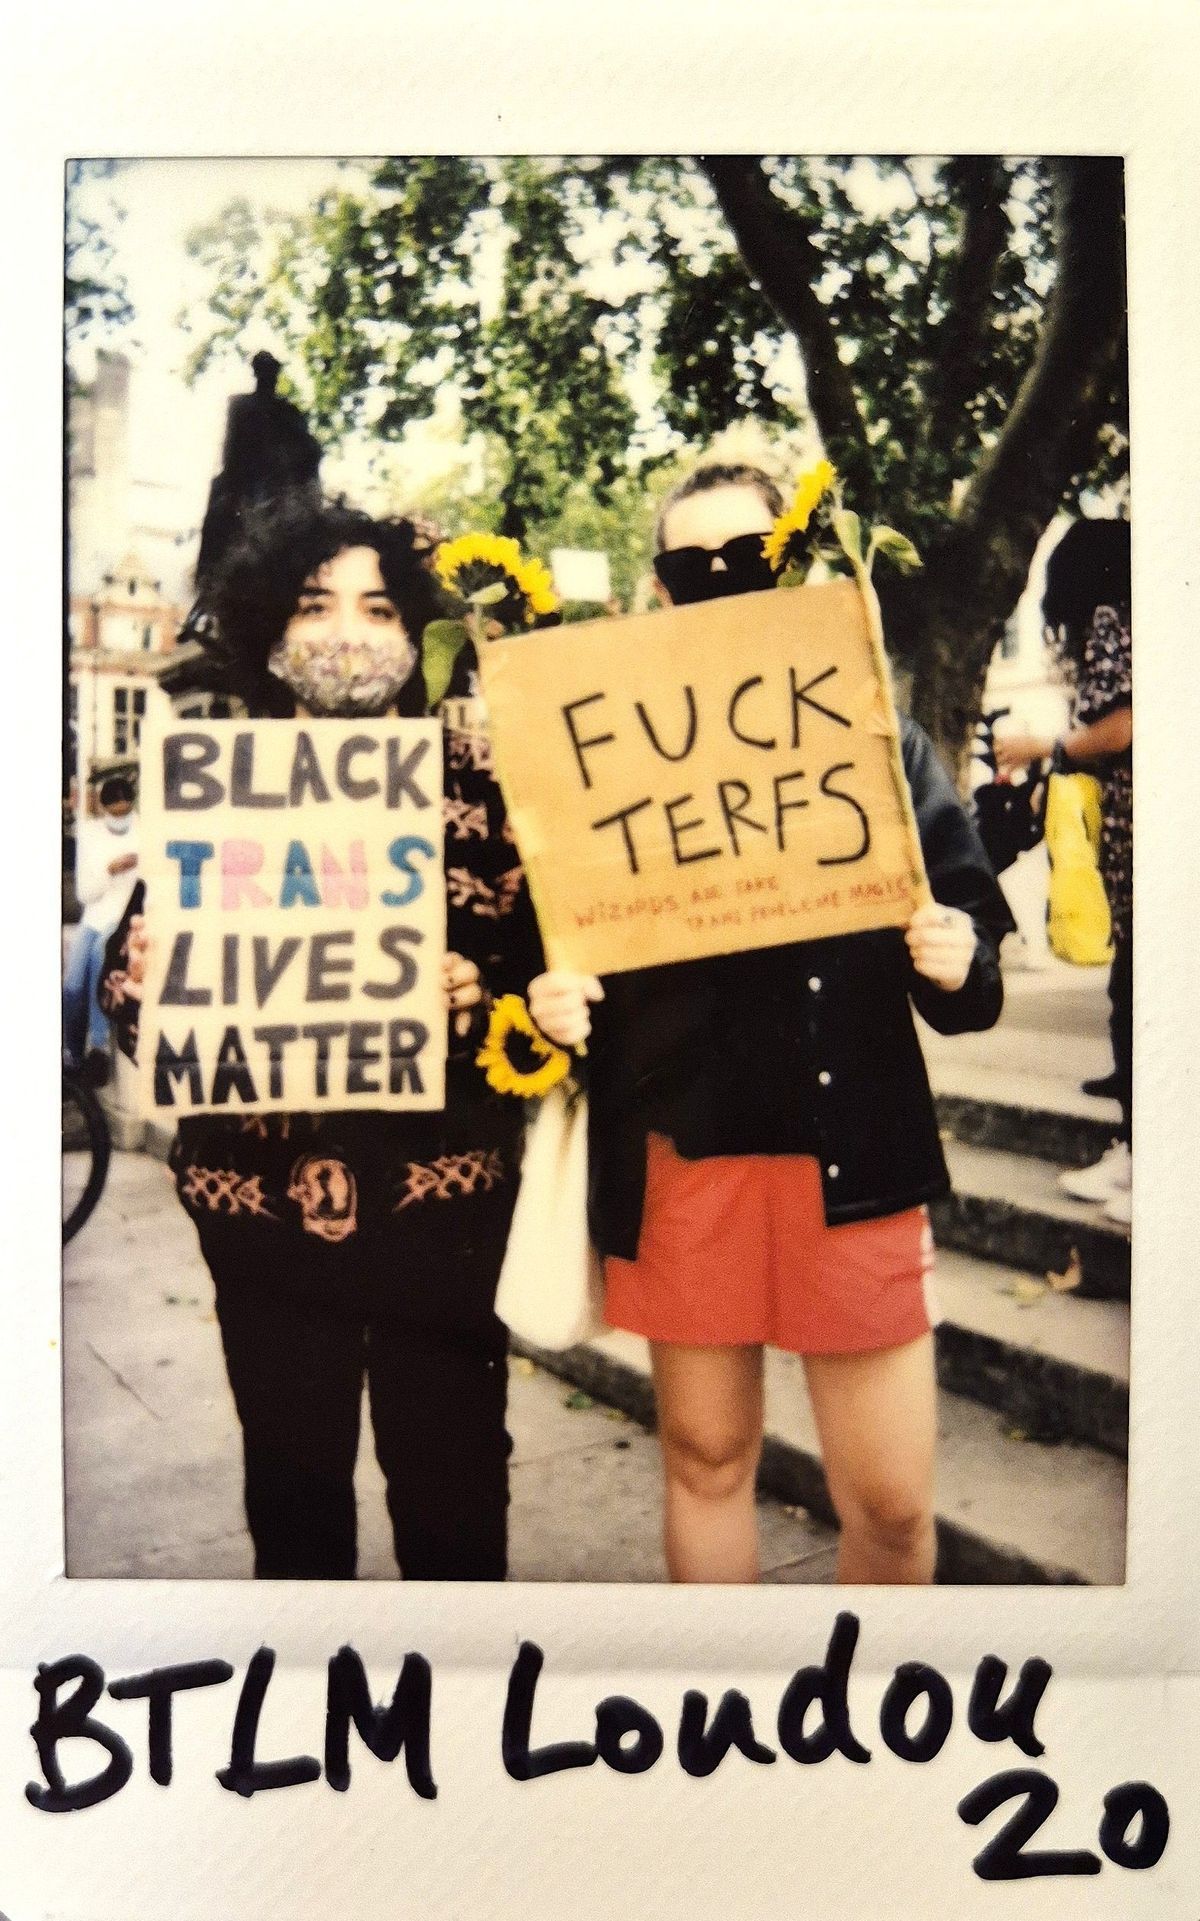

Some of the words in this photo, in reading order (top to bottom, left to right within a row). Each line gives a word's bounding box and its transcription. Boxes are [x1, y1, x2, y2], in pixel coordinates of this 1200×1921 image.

[161, 732, 432, 810] BLACK
[563, 667, 851, 788] FUCK
[593, 763, 870, 874] TERFS
[168, 837, 434, 907] TRANS
[159, 927, 423, 1009] LIVES
[154, 1019, 429, 1107] MATTER
[25, 1646, 437, 1813] BTLM
[502, 1613, 1052, 1781] London
[958, 1770, 1170, 1880] 20
